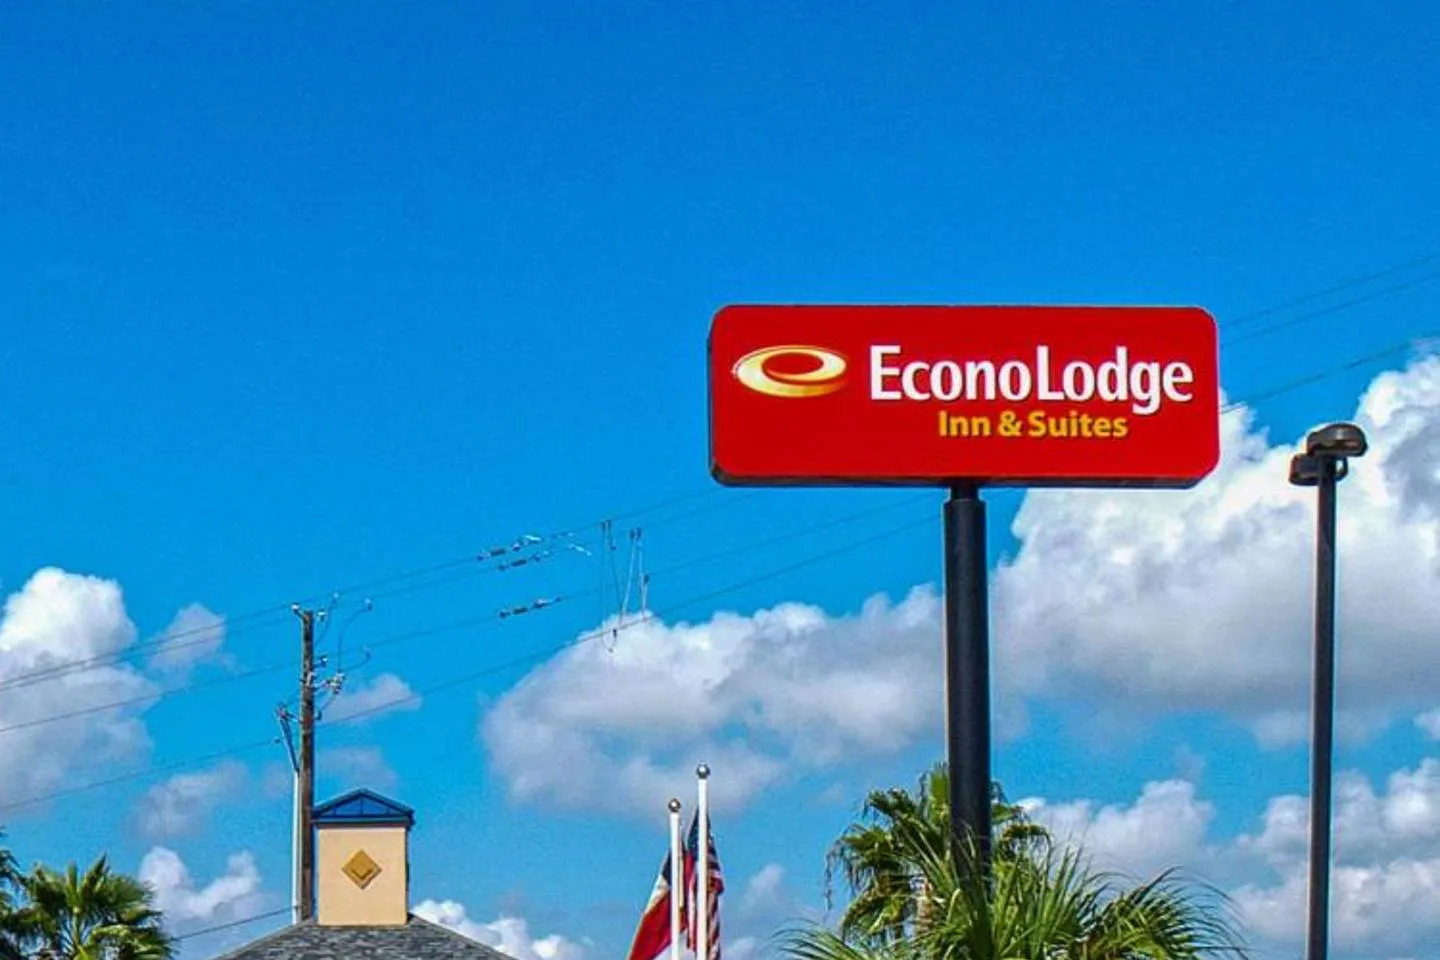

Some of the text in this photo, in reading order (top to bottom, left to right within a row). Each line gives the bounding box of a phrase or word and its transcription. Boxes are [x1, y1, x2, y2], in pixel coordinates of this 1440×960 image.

[869, 344, 1194, 415] EconoLodge
[938, 409, 1129, 438] Inn & Suites
